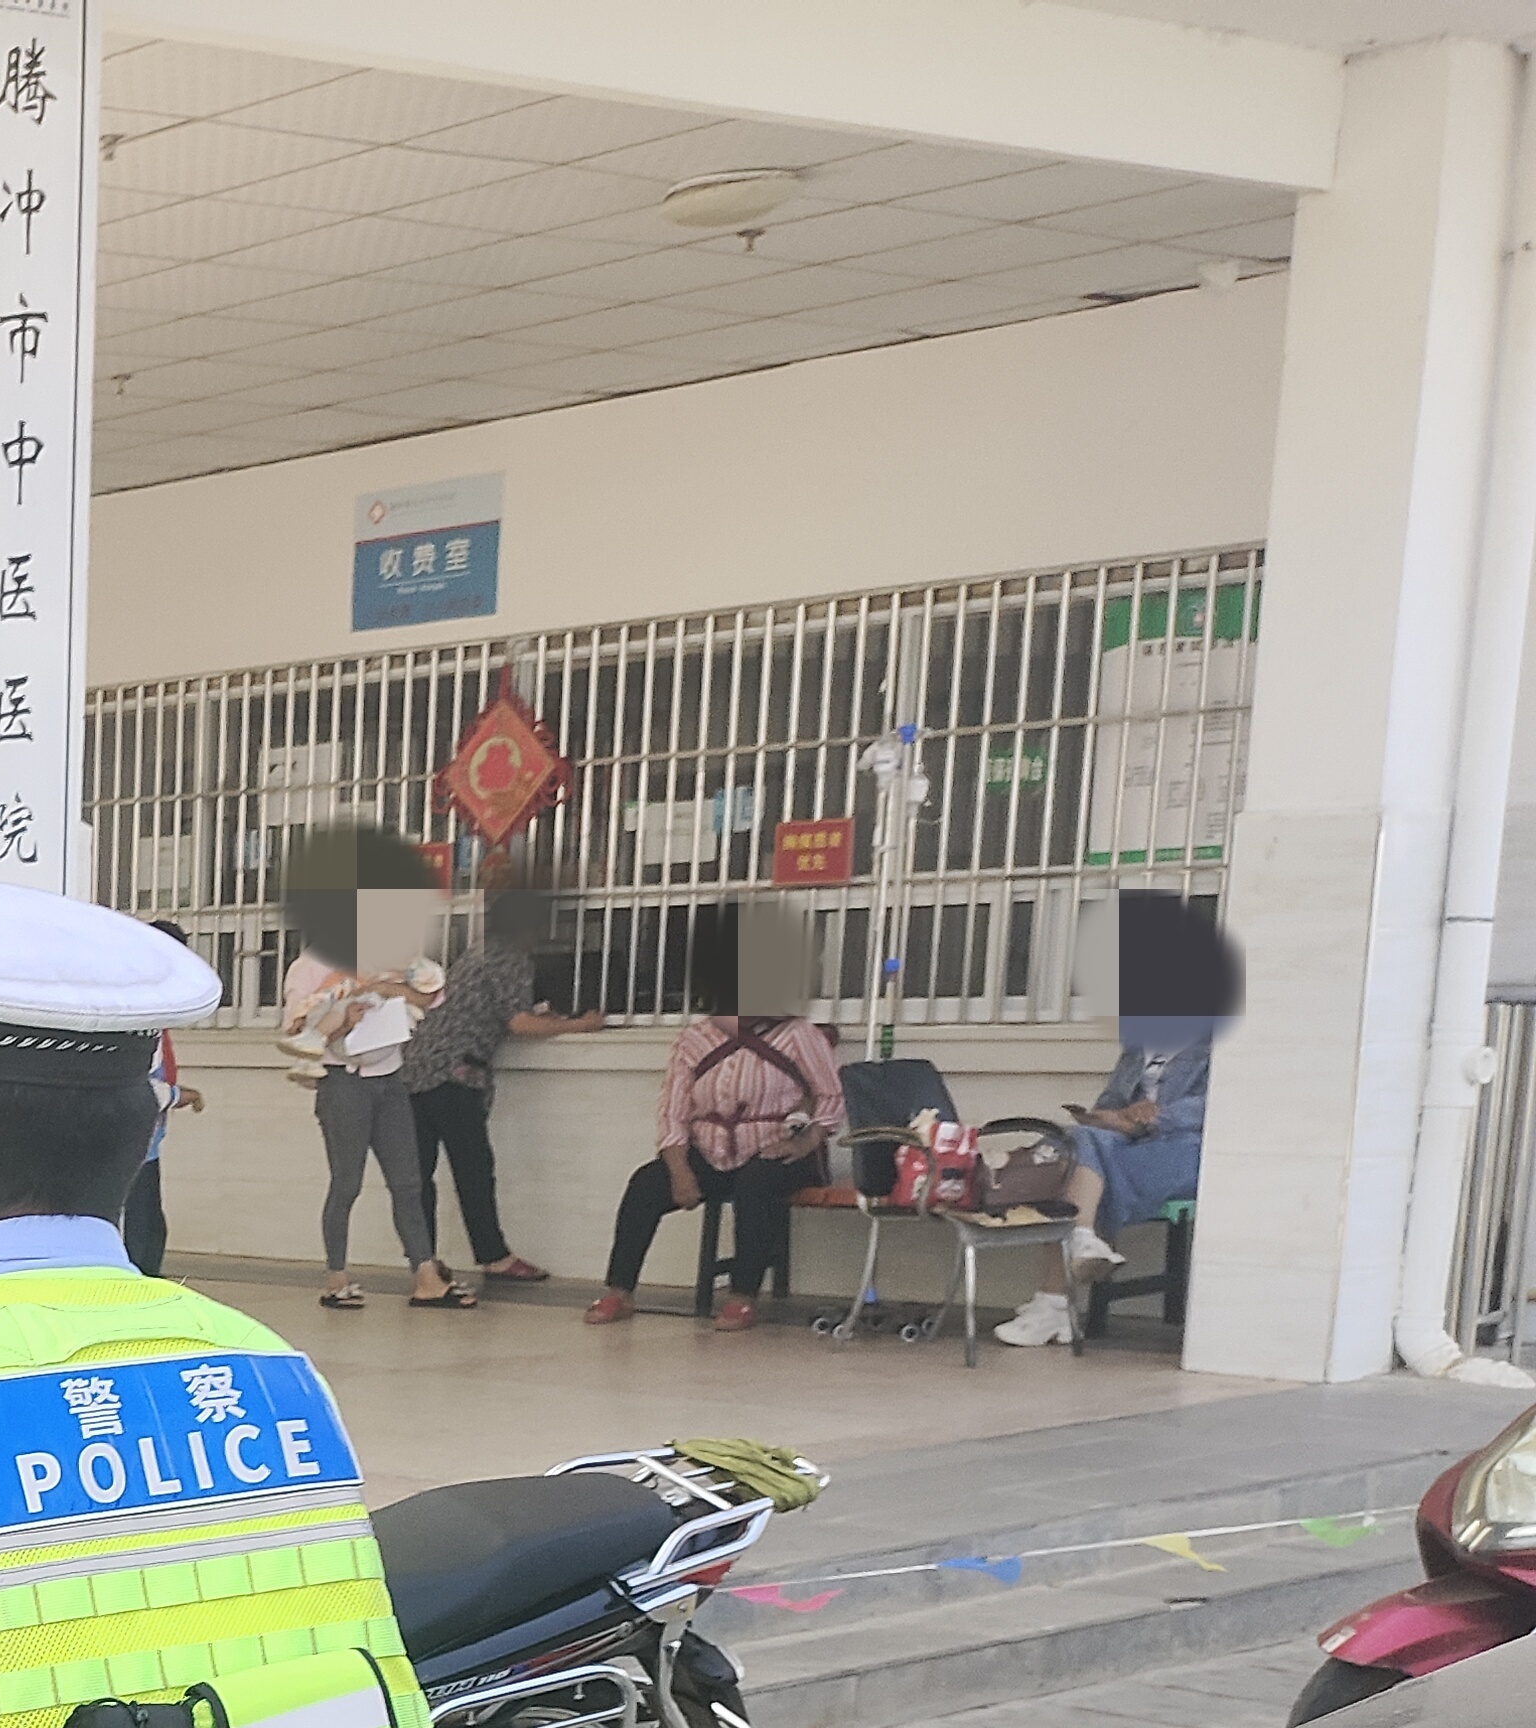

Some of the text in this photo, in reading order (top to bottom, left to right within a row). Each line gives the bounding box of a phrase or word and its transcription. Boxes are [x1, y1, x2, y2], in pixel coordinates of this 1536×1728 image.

[378, 538, 472, 581] 收费室
[60, 1364, 242, 1440] 警察
[15, 1419, 321, 1514] POLICE
